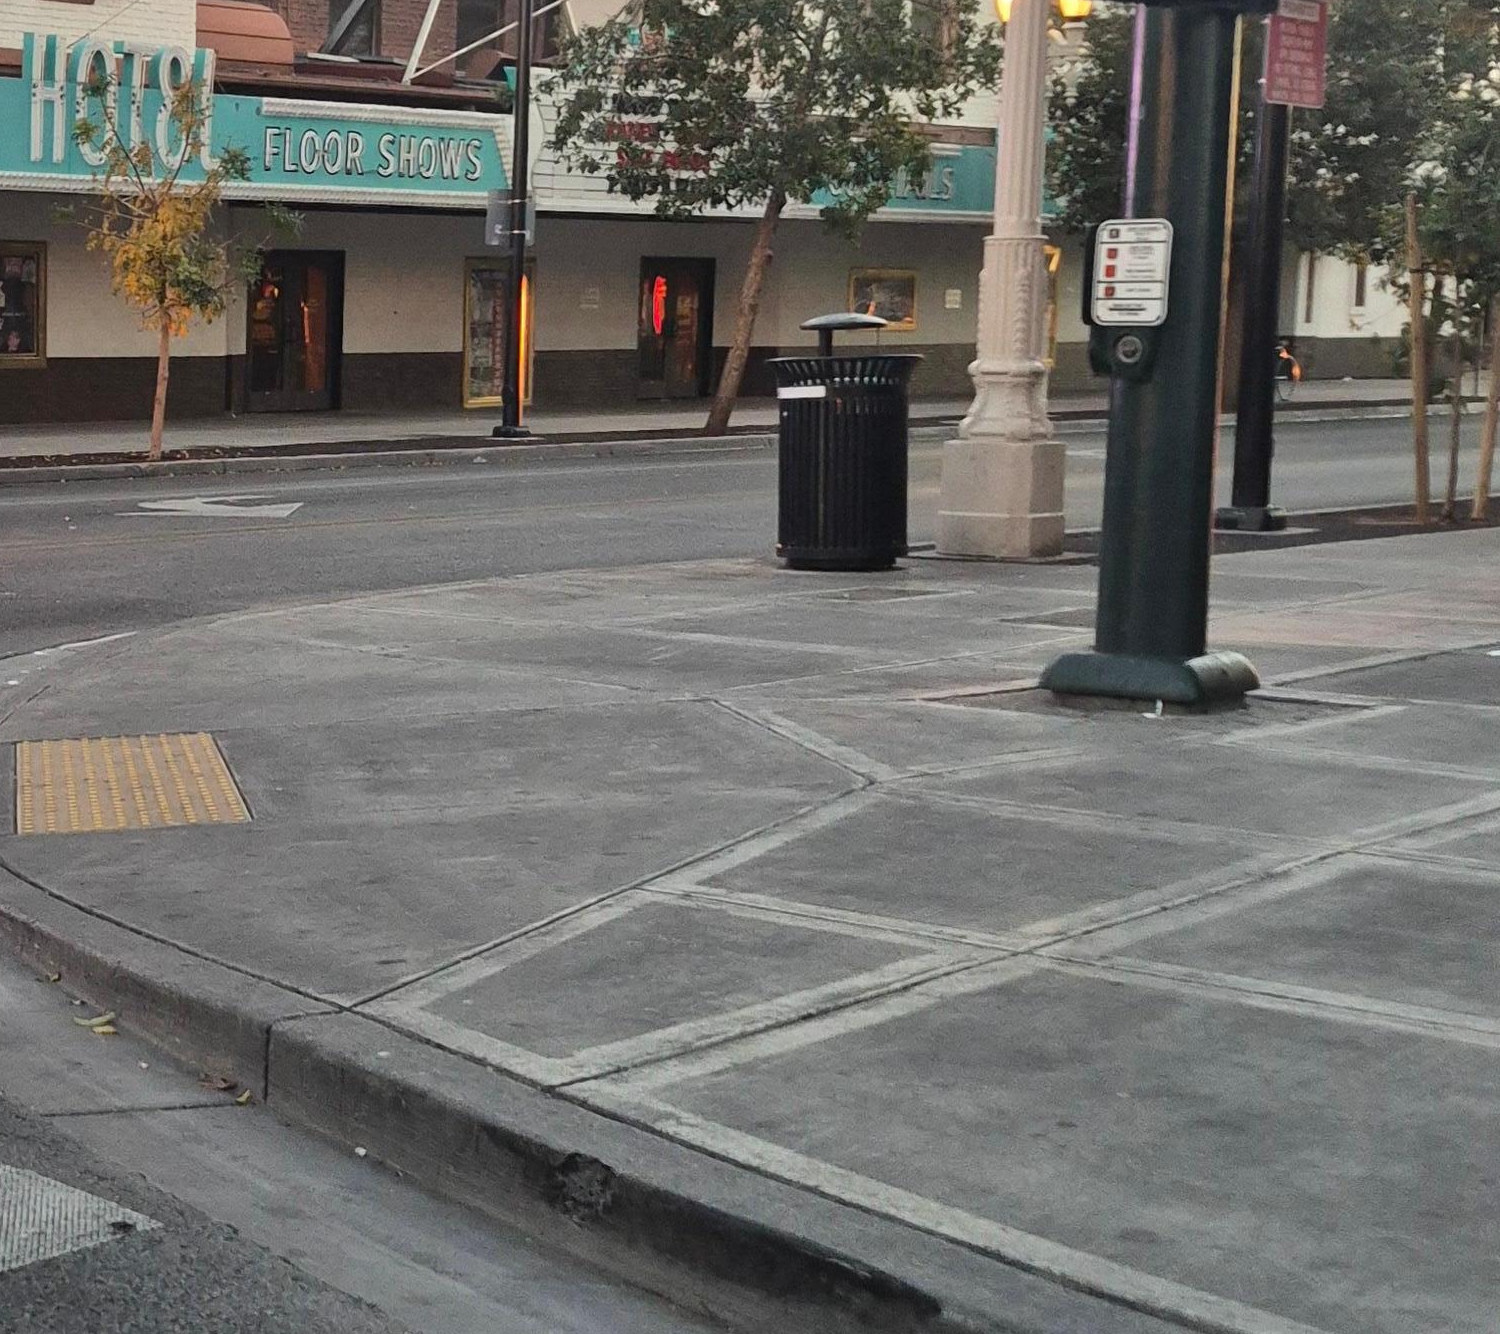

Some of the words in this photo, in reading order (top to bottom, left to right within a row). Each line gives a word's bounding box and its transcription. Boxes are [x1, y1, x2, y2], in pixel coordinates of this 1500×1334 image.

[23, 31, 221, 172] HOTEL
[264, 126, 365, 176] FLOOR
[376, 132, 483, 181] SHOWS
